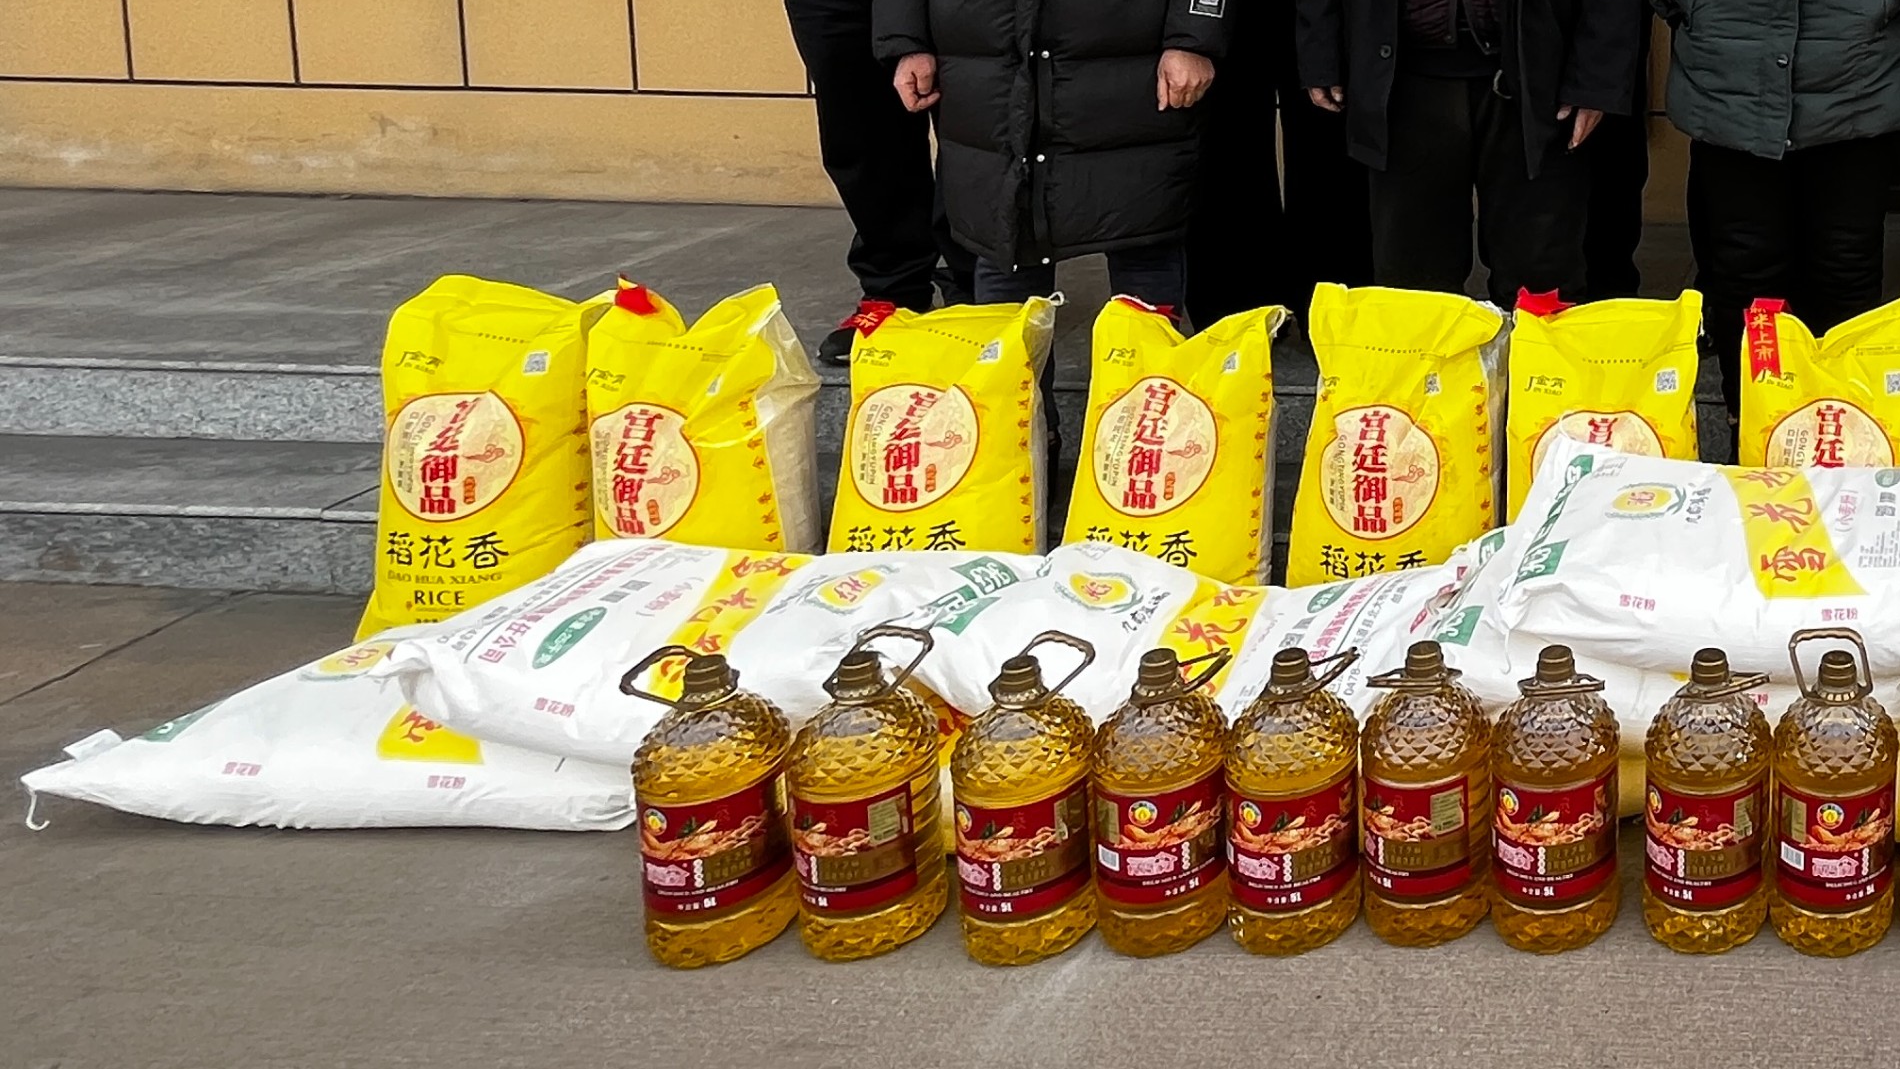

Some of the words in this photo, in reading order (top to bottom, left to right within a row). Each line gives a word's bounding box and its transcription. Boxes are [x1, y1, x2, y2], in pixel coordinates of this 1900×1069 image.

[1122, 383, 1177, 510] 宫廷御品
[612, 409, 664, 535] 宫廷御品
[1352, 410, 1391, 533] 宫廷御品
[386, 532, 509, 569] 稻花香
[415, 574, 445, 585] HUA
[450, 573, 502, 585] XIANG
[414, 590, 465, 606] RICE
[1618, 593, 1657, 612] 雪花粉
[1820, 607, 1859, 623] 雪花粉
